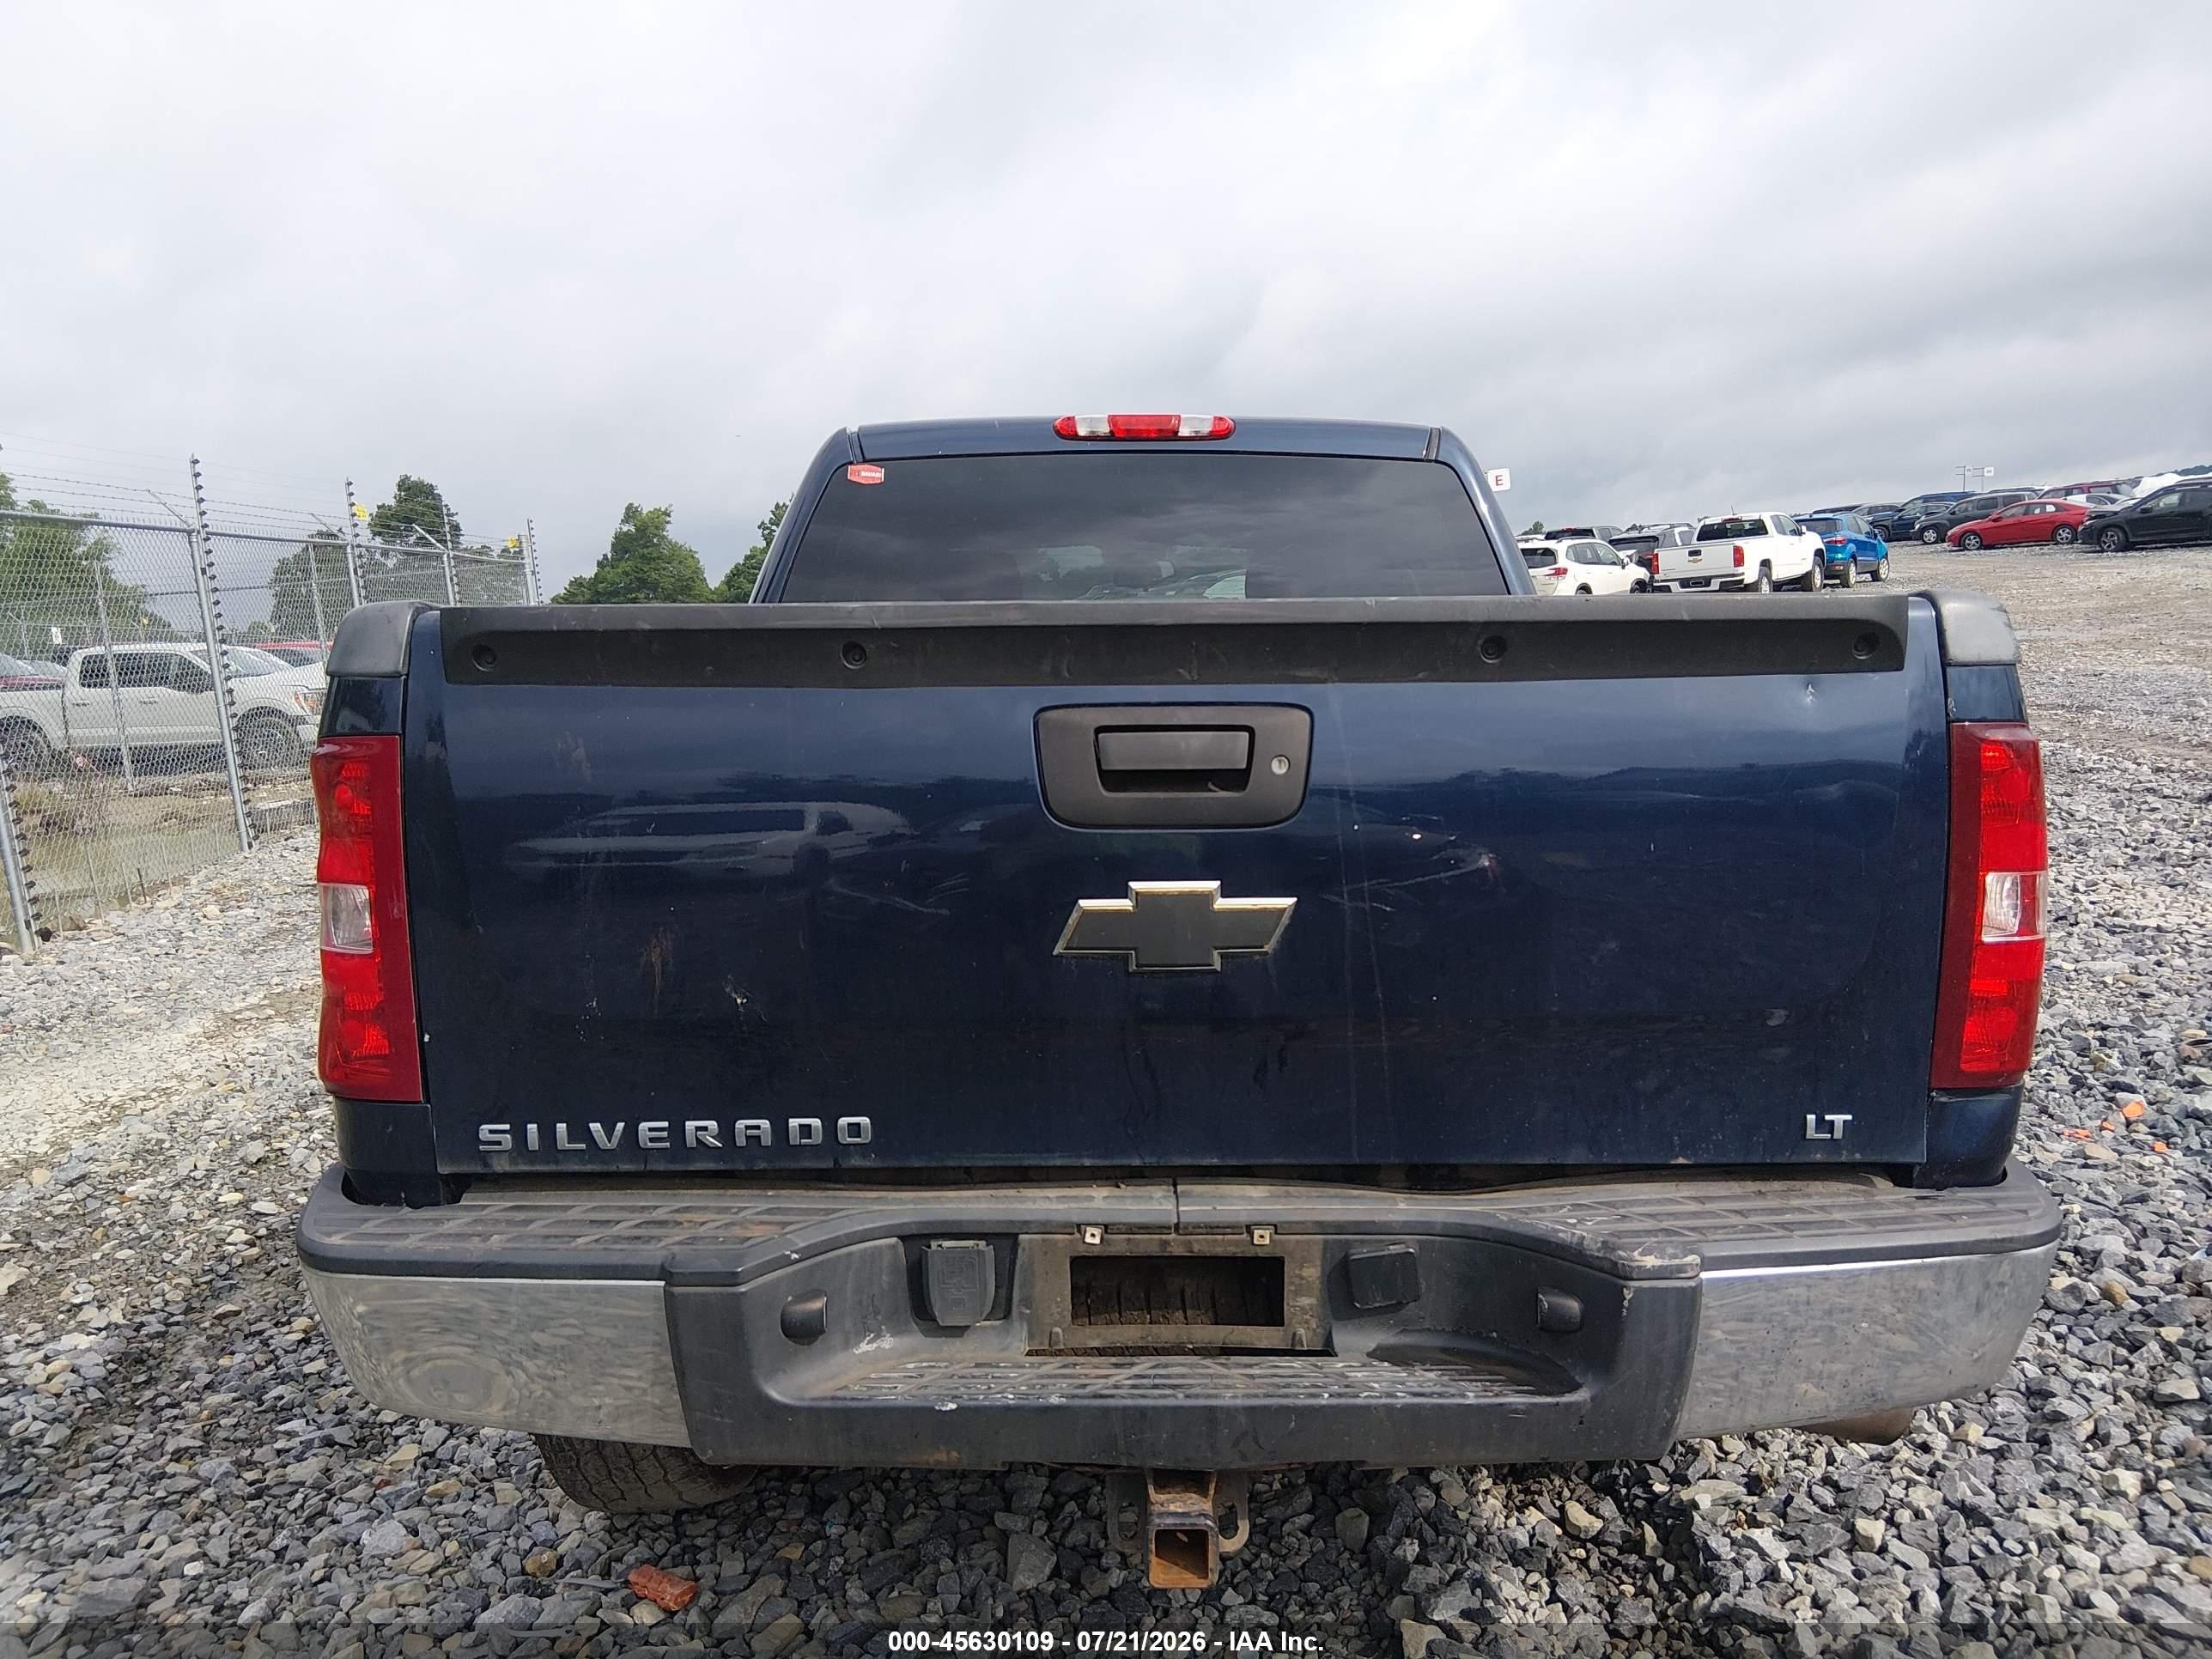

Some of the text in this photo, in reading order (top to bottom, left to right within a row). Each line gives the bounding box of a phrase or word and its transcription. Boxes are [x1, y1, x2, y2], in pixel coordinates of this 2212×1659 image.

[1495, 474, 1504, 486] E
[478, 1116, 872, 1152] SILVERADO
[1806, 1114, 1853, 1139] LT
